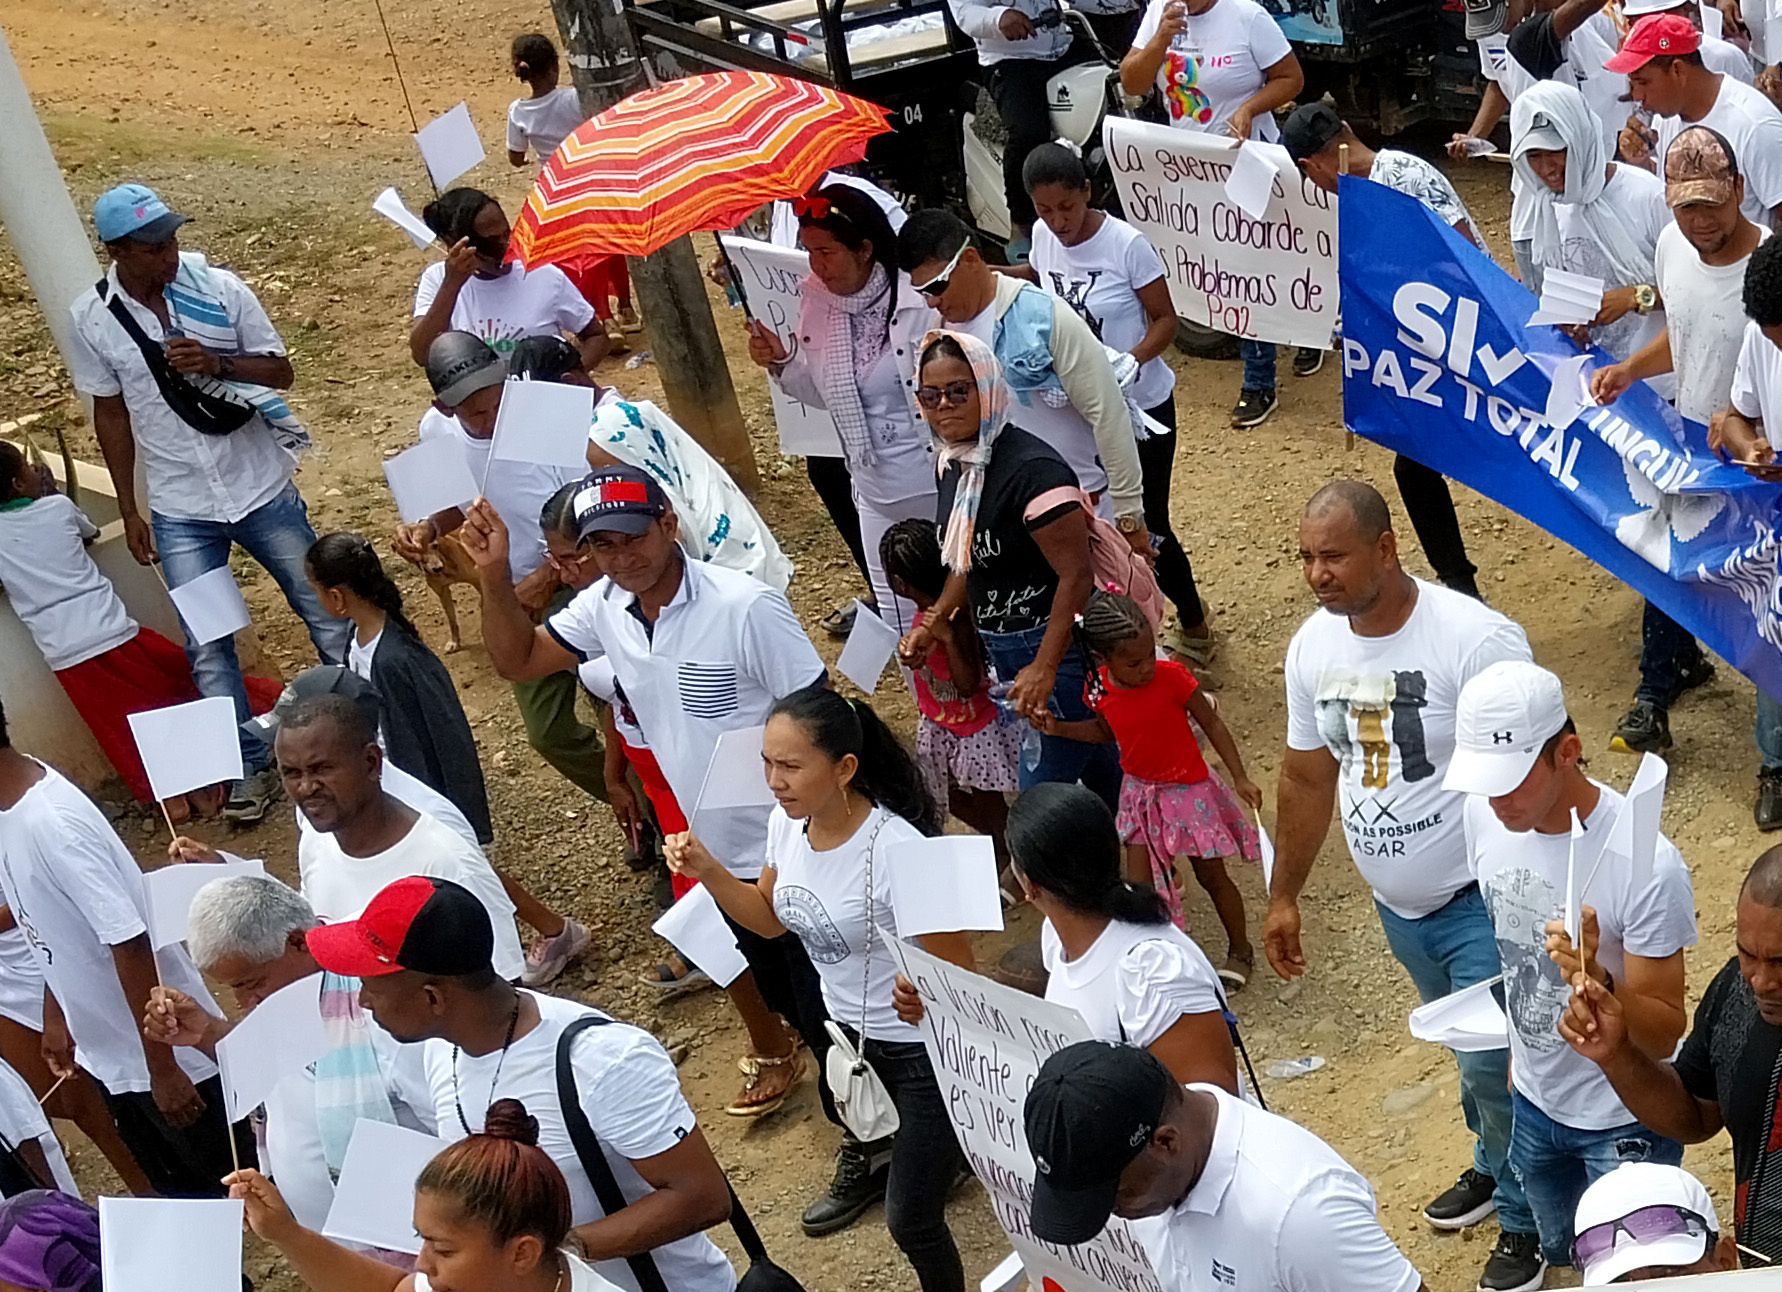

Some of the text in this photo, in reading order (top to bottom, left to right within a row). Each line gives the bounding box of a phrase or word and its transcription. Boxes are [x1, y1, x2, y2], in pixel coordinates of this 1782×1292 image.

[904, 103, 923, 125] 04
[1109, 127, 1145, 173] La
[1130, 182, 1198, 236] Salida
[1317, 231, 1332, 258] a
[1175, 245, 1276, 306] Problemas
[1291, 268, 1323, 312] de
[1393, 282, 1479, 377] SI
[1343, 337, 1582, 492] PAZ TOTAL
[1354, 839, 1406, 857] ASAR
[1363, 827, 1376, 838] AS
[1379, 813, 1443, 838] POSSIBLE
